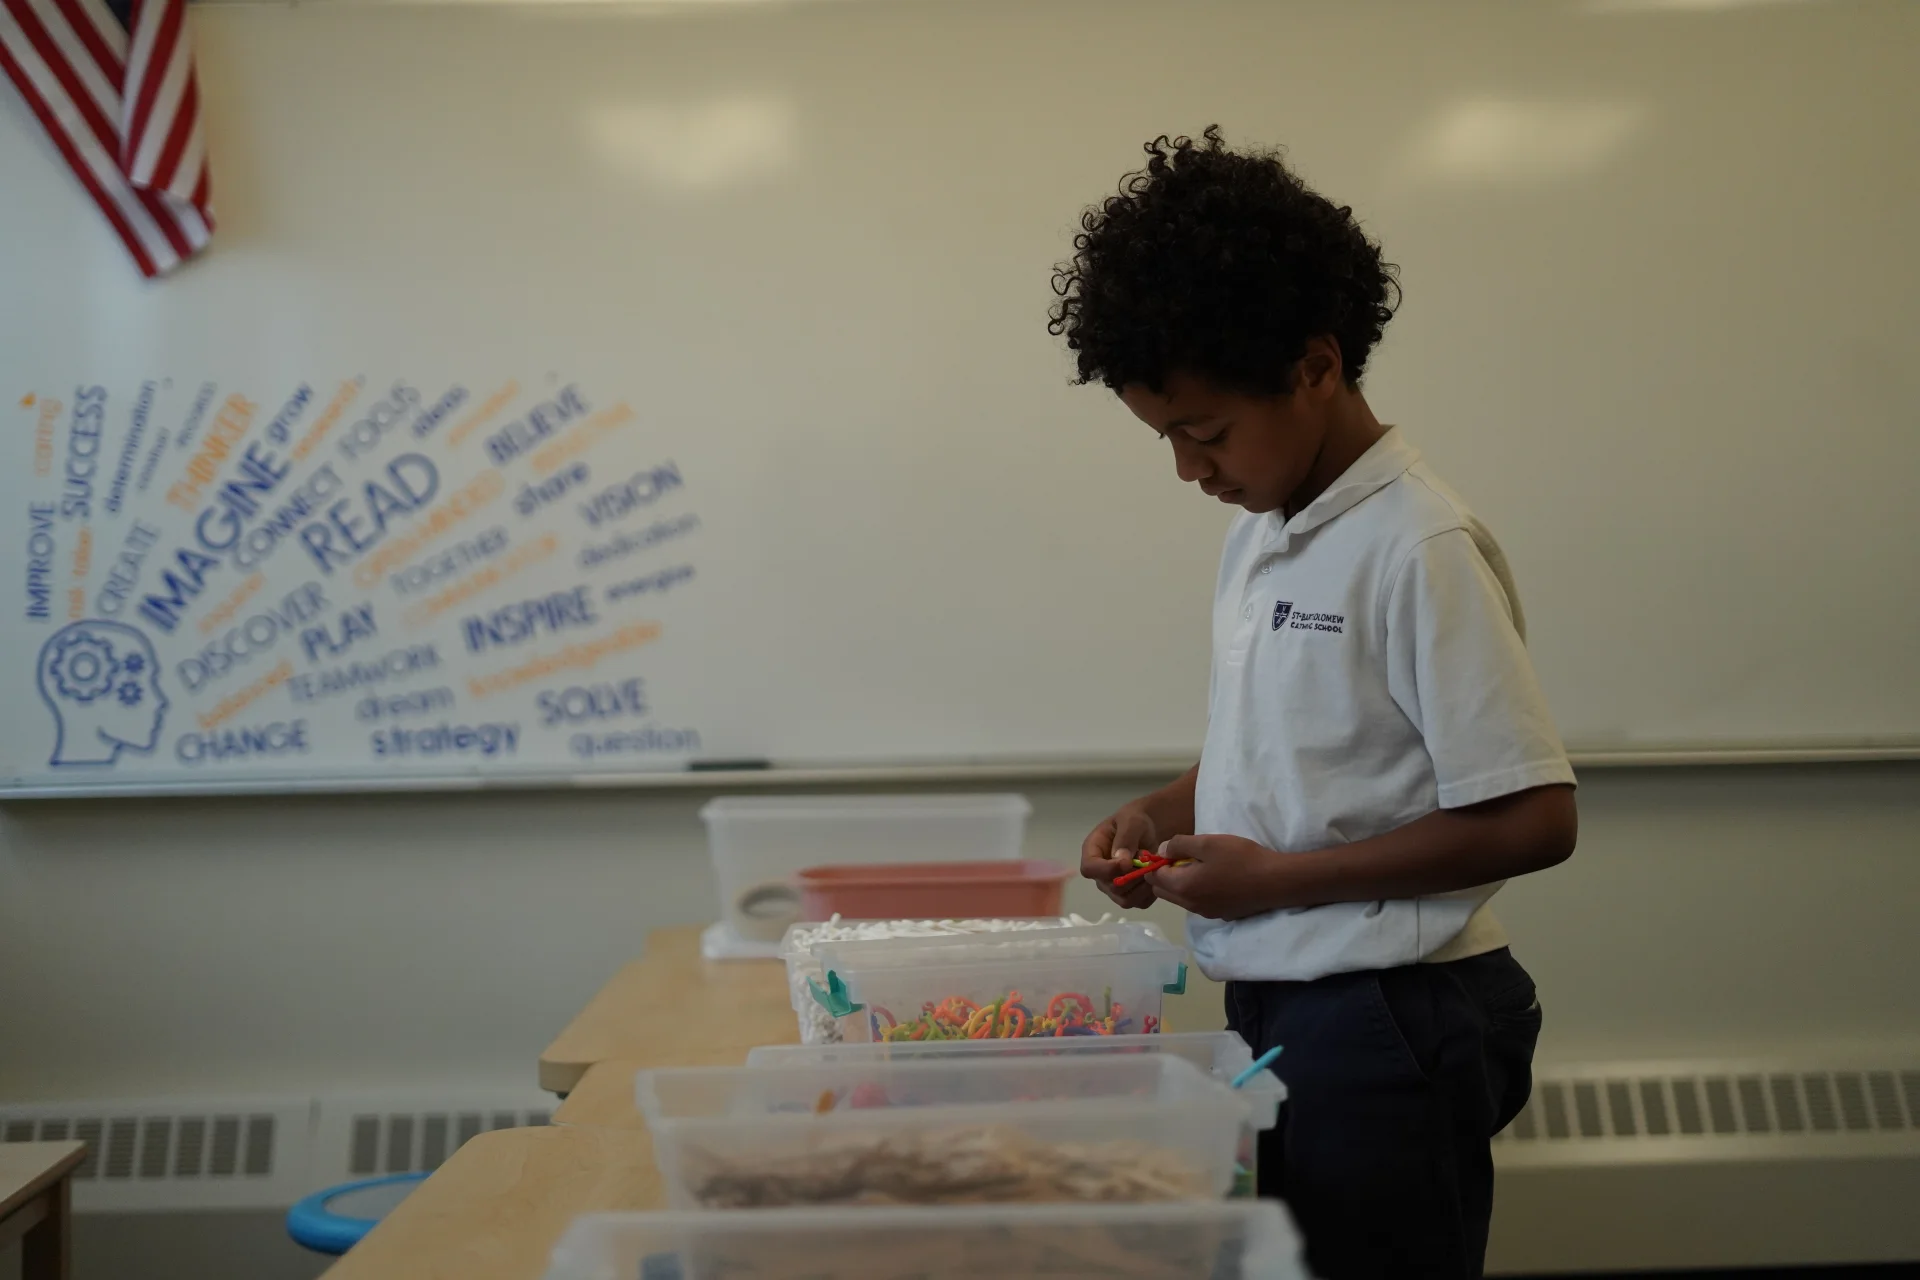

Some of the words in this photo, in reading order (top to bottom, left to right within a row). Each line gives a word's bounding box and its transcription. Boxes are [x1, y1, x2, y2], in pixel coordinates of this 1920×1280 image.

[61, 385, 108, 519] SUCCESS
[105, 380, 158, 515] determination
[166, 391, 258, 512] THINKER
[267, 383, 315, 444] grow
[338, 382, 421, 460] FOCUS
[486, 383, 591, 466] BELIEVE
[233, 462, 344, 570] CONNECT
[301, 452, 440, 574] READ
[578, 458, 684, 526] VISION
[25, 501, 56, 619] IMPROVE
[96, 519, 161, 615] CREATE
[138, 440, 292, 633] IMAGINE
[177, 581, 325, 693] DISCOVER
[301, 603, 377, 661] PLAY
[462, 585, 599, 654] INSPIRE
[1314, 623, 1343, 633] SCHOOL
[289, 644, 442, 702] TEAMWORK
[536, 677, 648, 727] SOLVE
[175, 719, 309, 764] CHANGE
[370, 722, 520, 758] strategy
